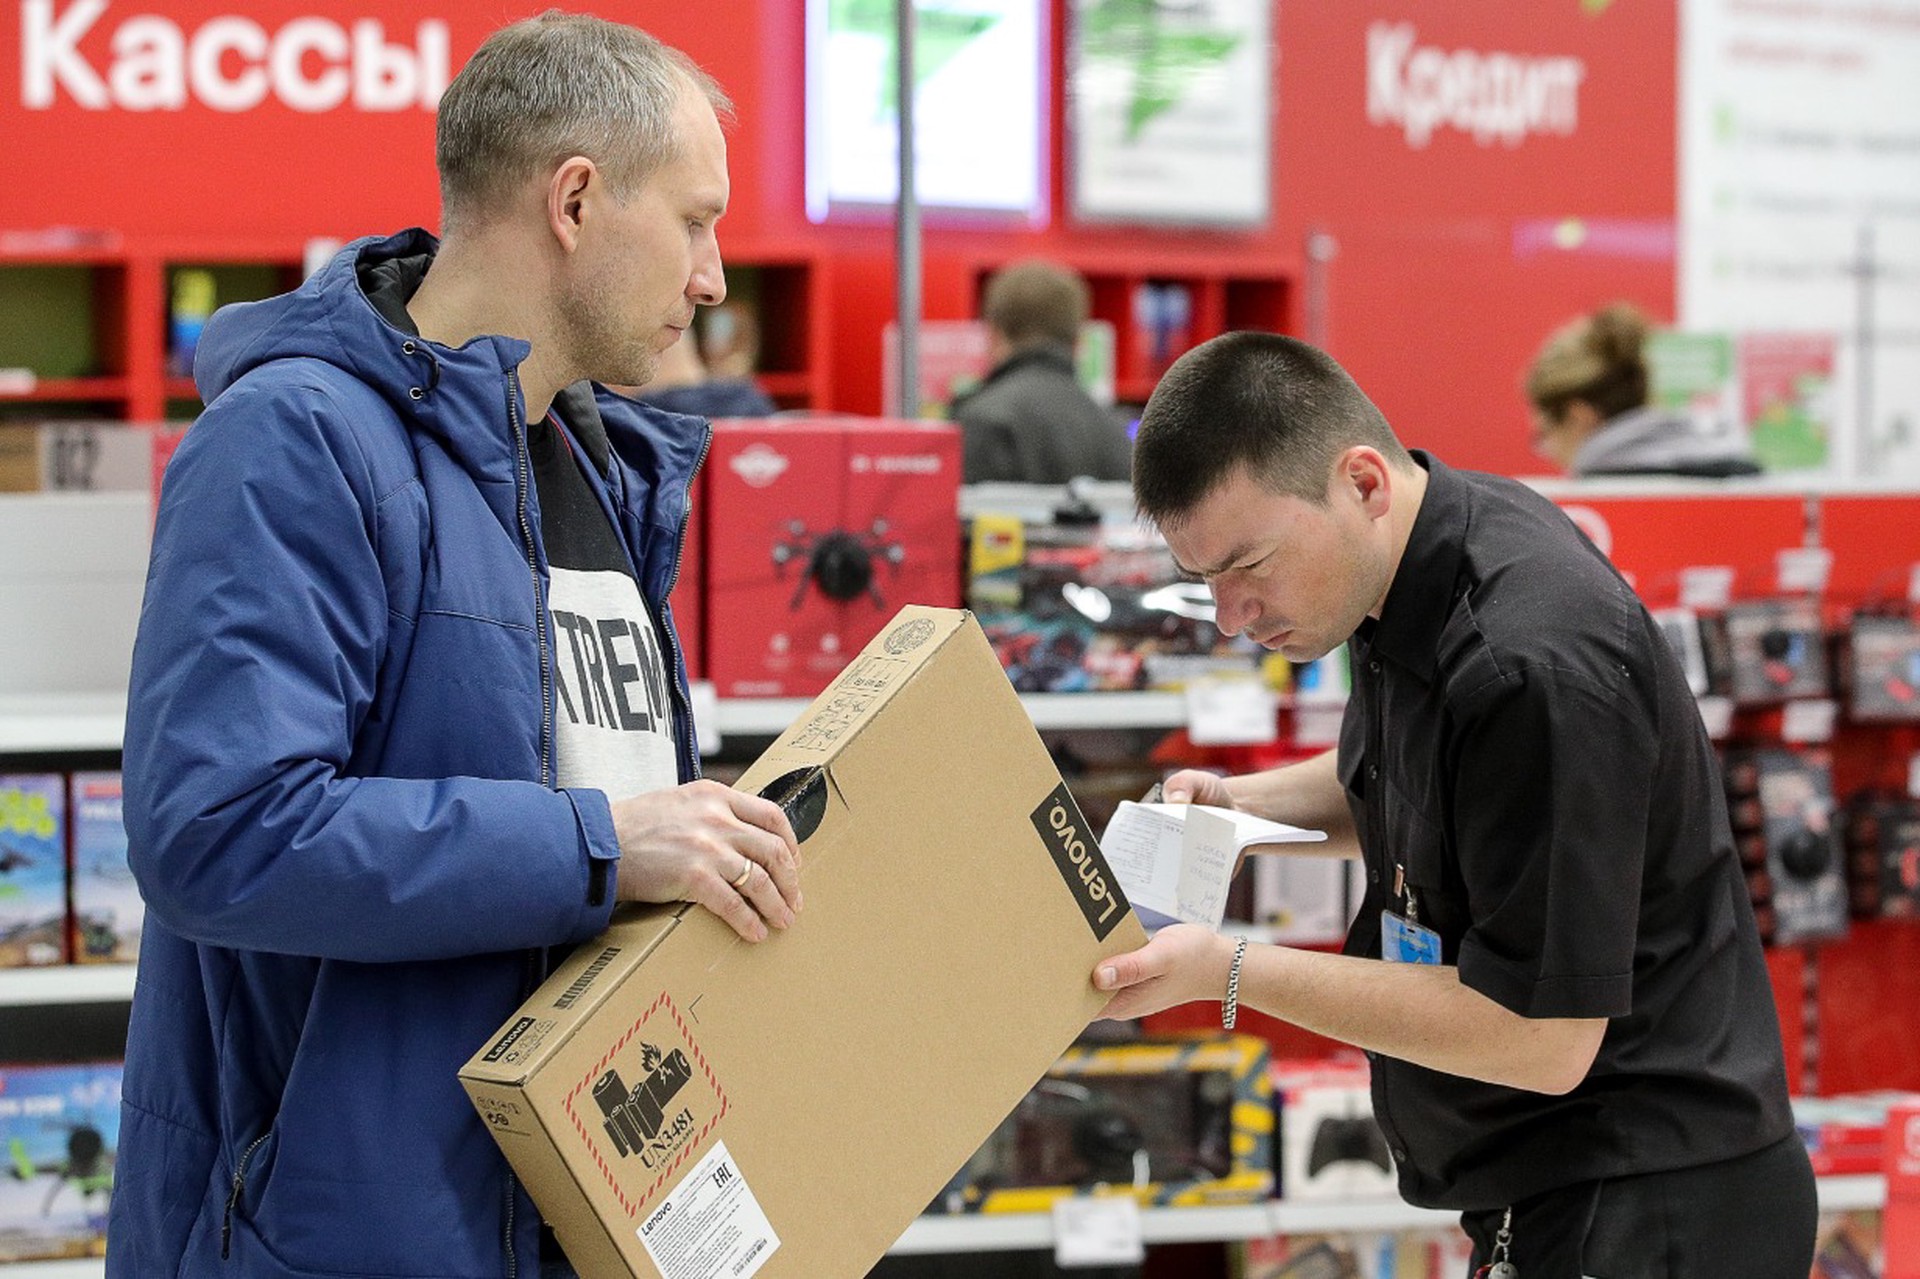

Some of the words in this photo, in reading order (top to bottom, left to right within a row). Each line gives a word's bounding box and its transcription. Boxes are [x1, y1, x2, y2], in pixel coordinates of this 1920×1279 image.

[20, 0, 451, 111] Кассы
[1367, 20, 1585, 149] Кредит
[549, 609, 675, 742] XTREM
[1050, 804, 1118, 924] Lenovo
[488, 1020, 529, 1060] Lenovo
[641, 1107, 694, 1168] UN3481
[712, 1162, 733, 1188] EAC
[641, 1202, 673, 1236] Lenovo
